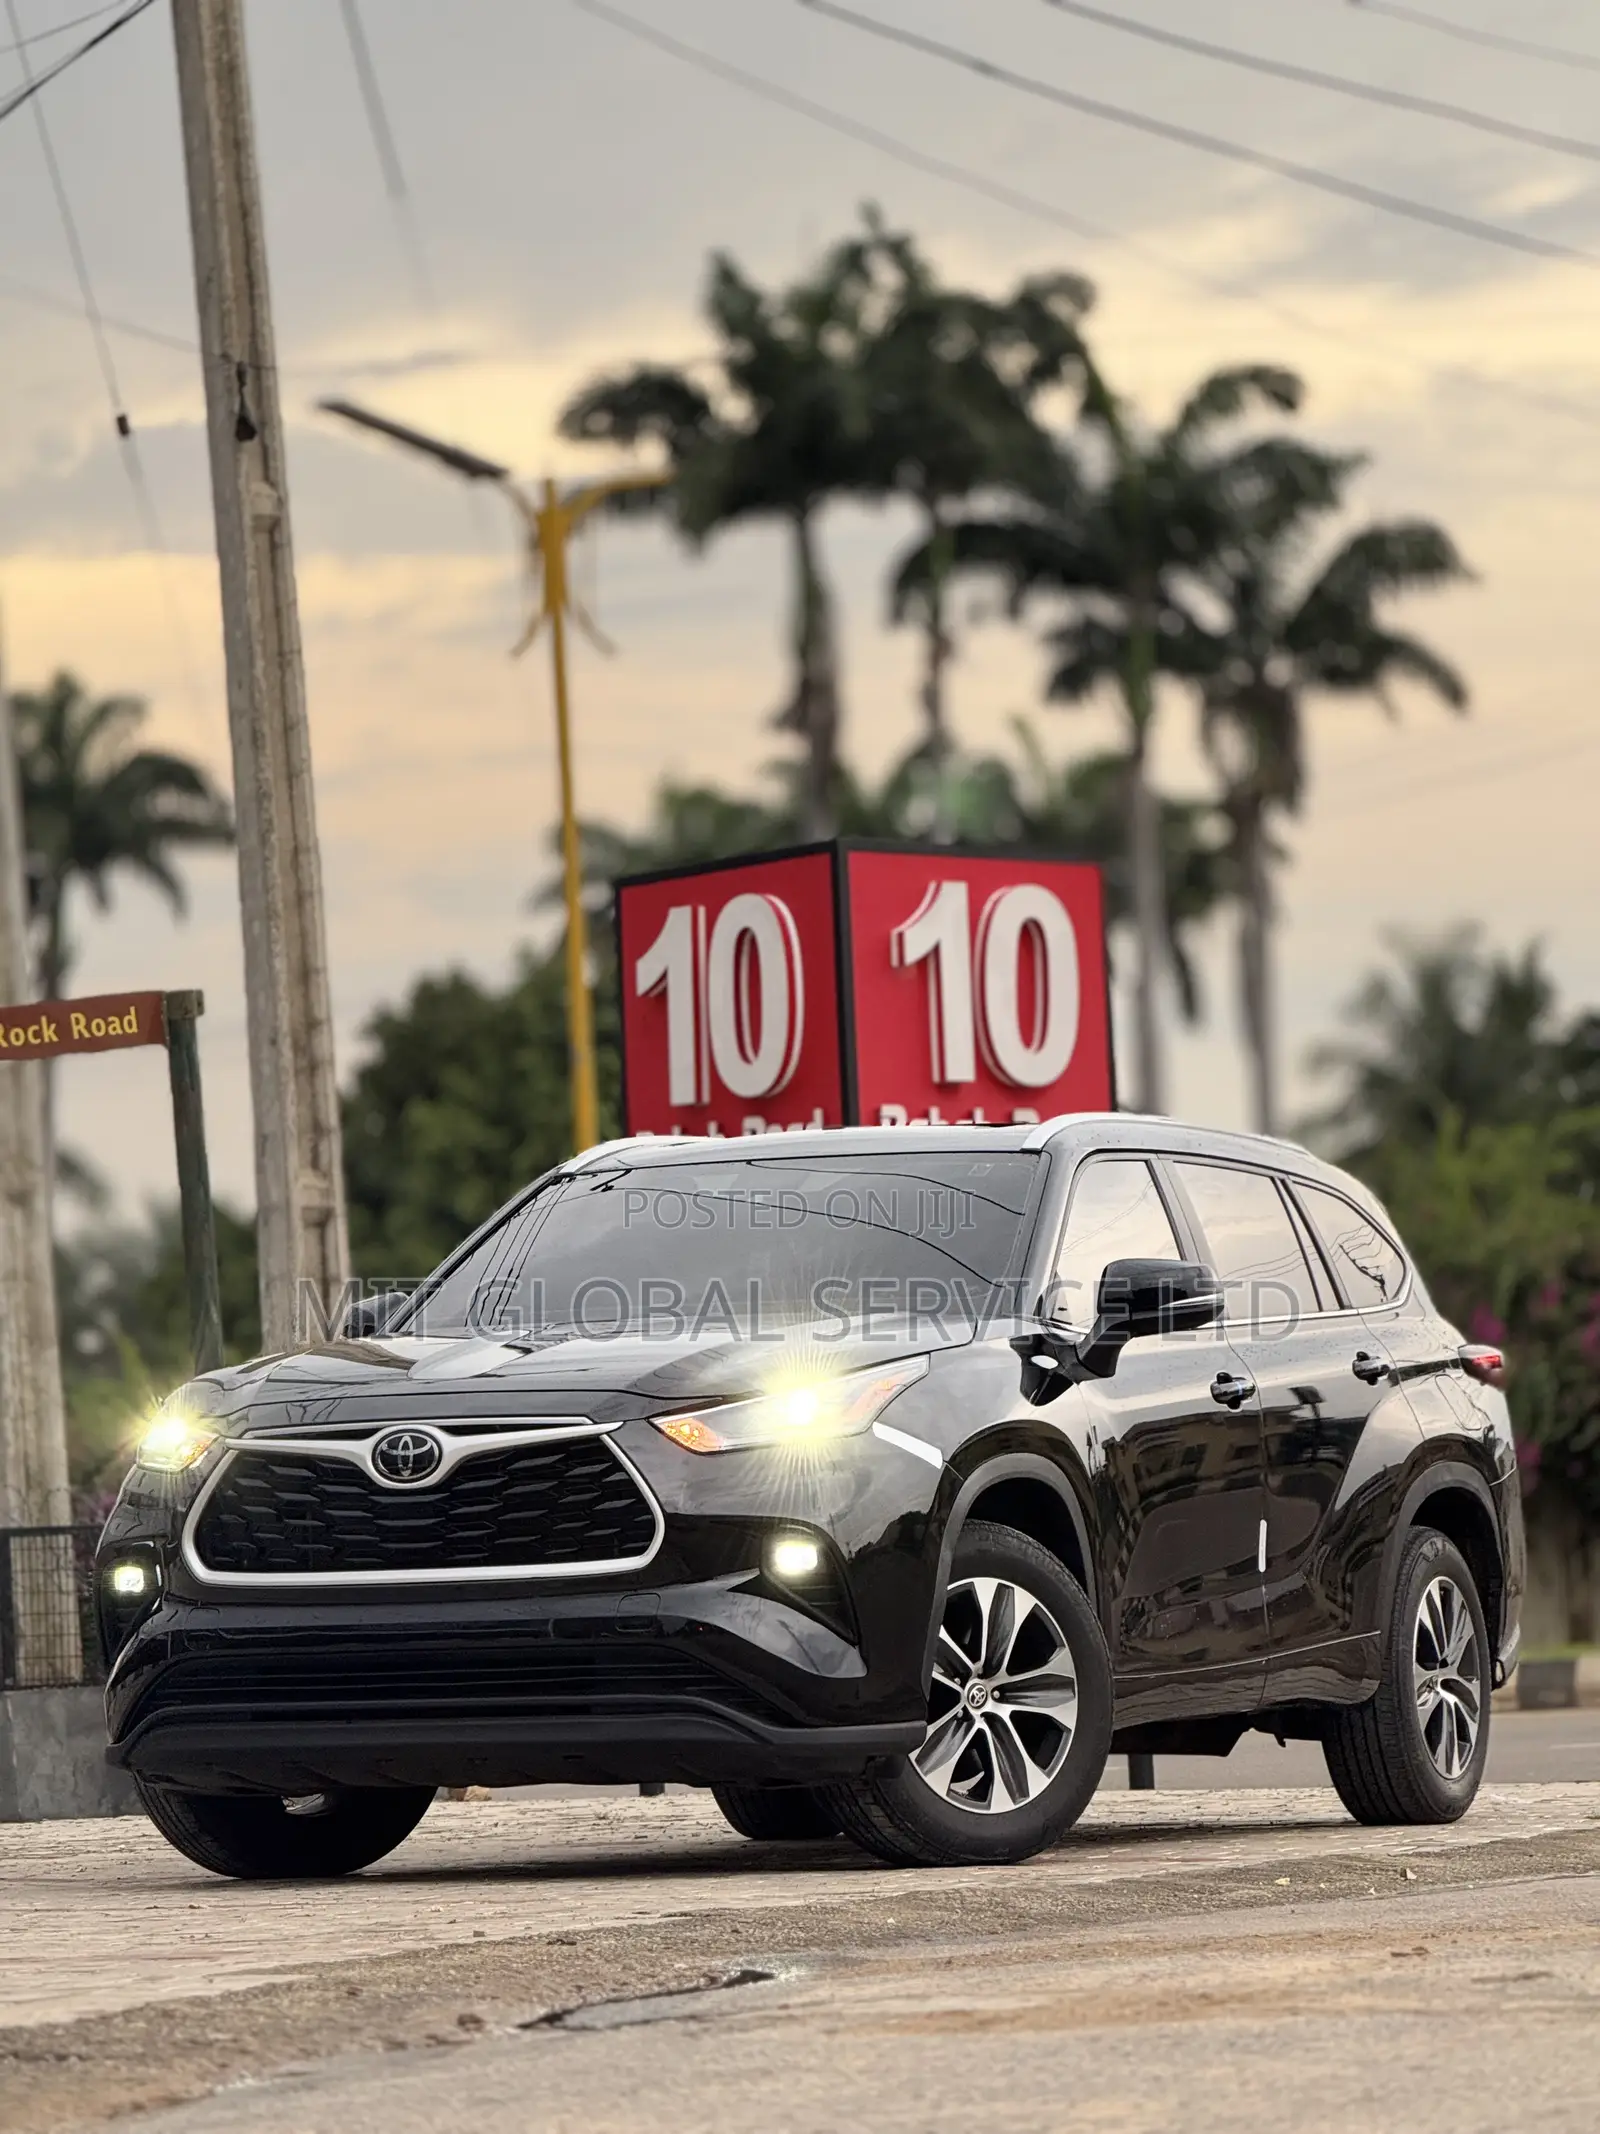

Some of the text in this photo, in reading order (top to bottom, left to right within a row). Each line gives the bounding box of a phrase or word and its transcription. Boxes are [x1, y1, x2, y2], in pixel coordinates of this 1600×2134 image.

[70, 1006, 138, 1039] Road
[635, 892, 804, 1106] 10
[891, 880, 1080, 1087] 10
